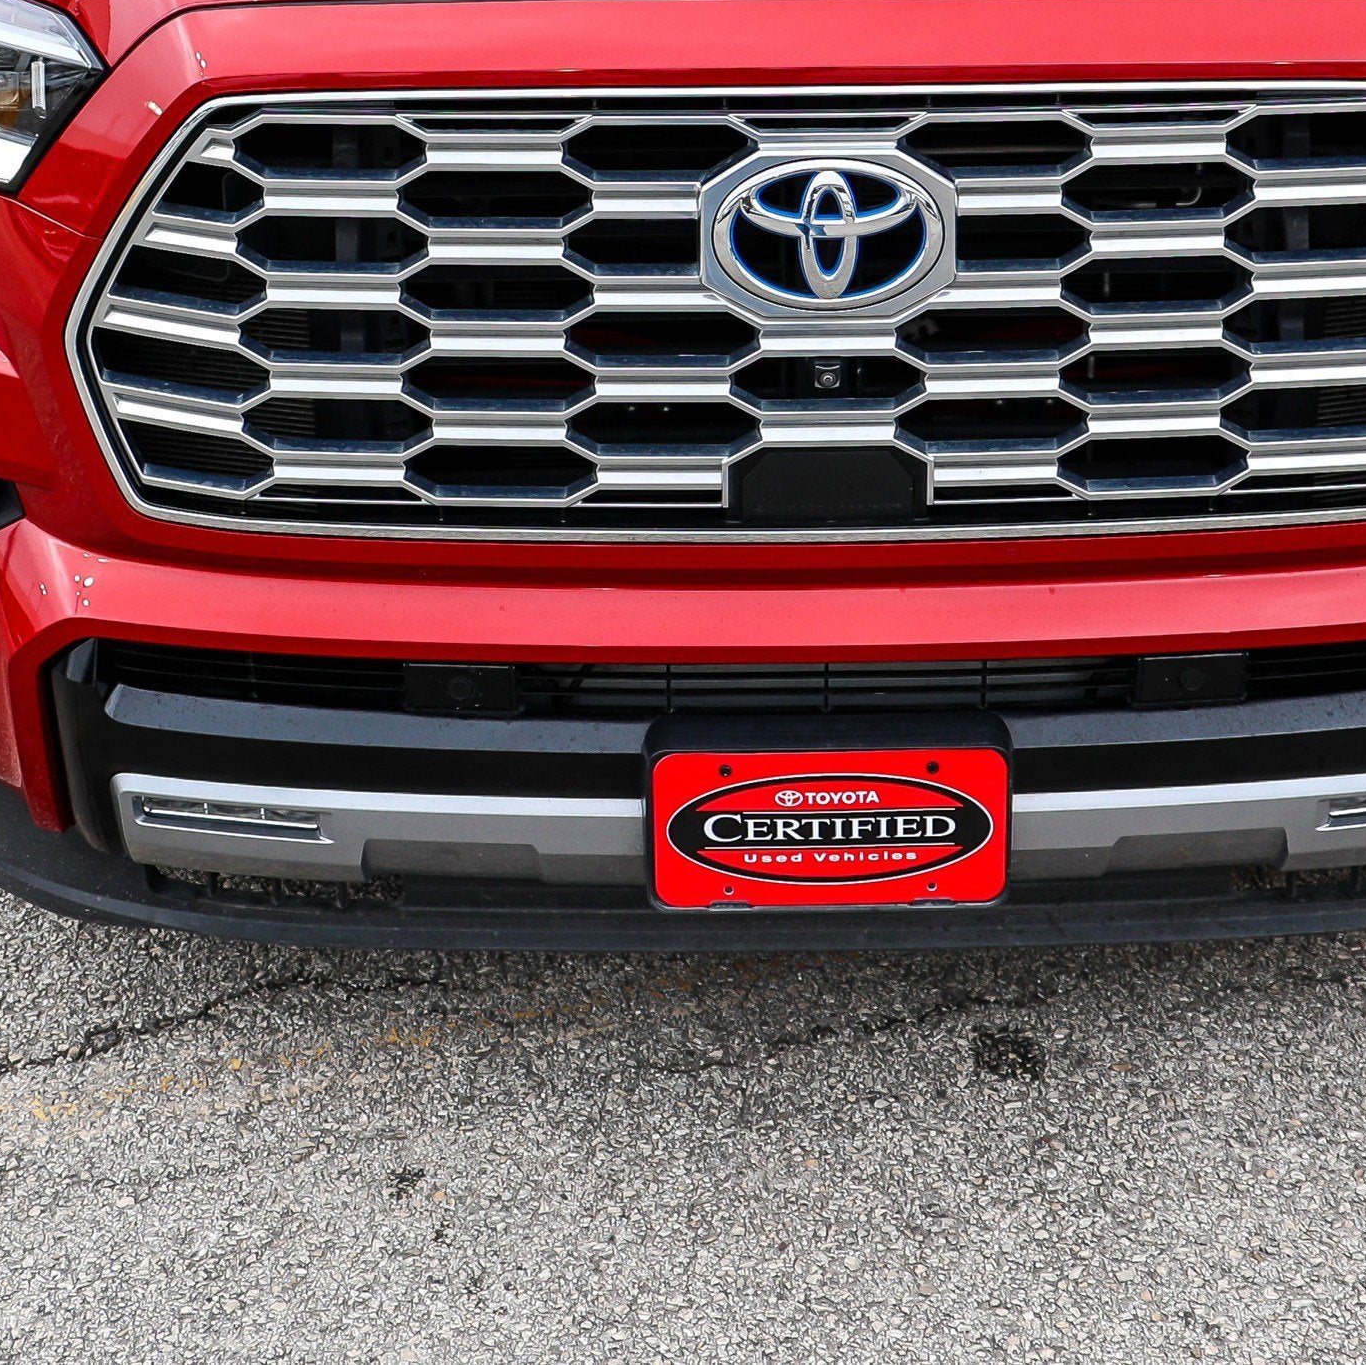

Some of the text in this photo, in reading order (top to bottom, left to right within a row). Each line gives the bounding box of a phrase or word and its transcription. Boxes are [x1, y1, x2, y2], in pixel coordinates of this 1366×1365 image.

[805, 790, 879, 805] TOYOTA
[703, 814, 956, 843] CERTIFIED
[743, 851, 918, 864] Used Vehicles
